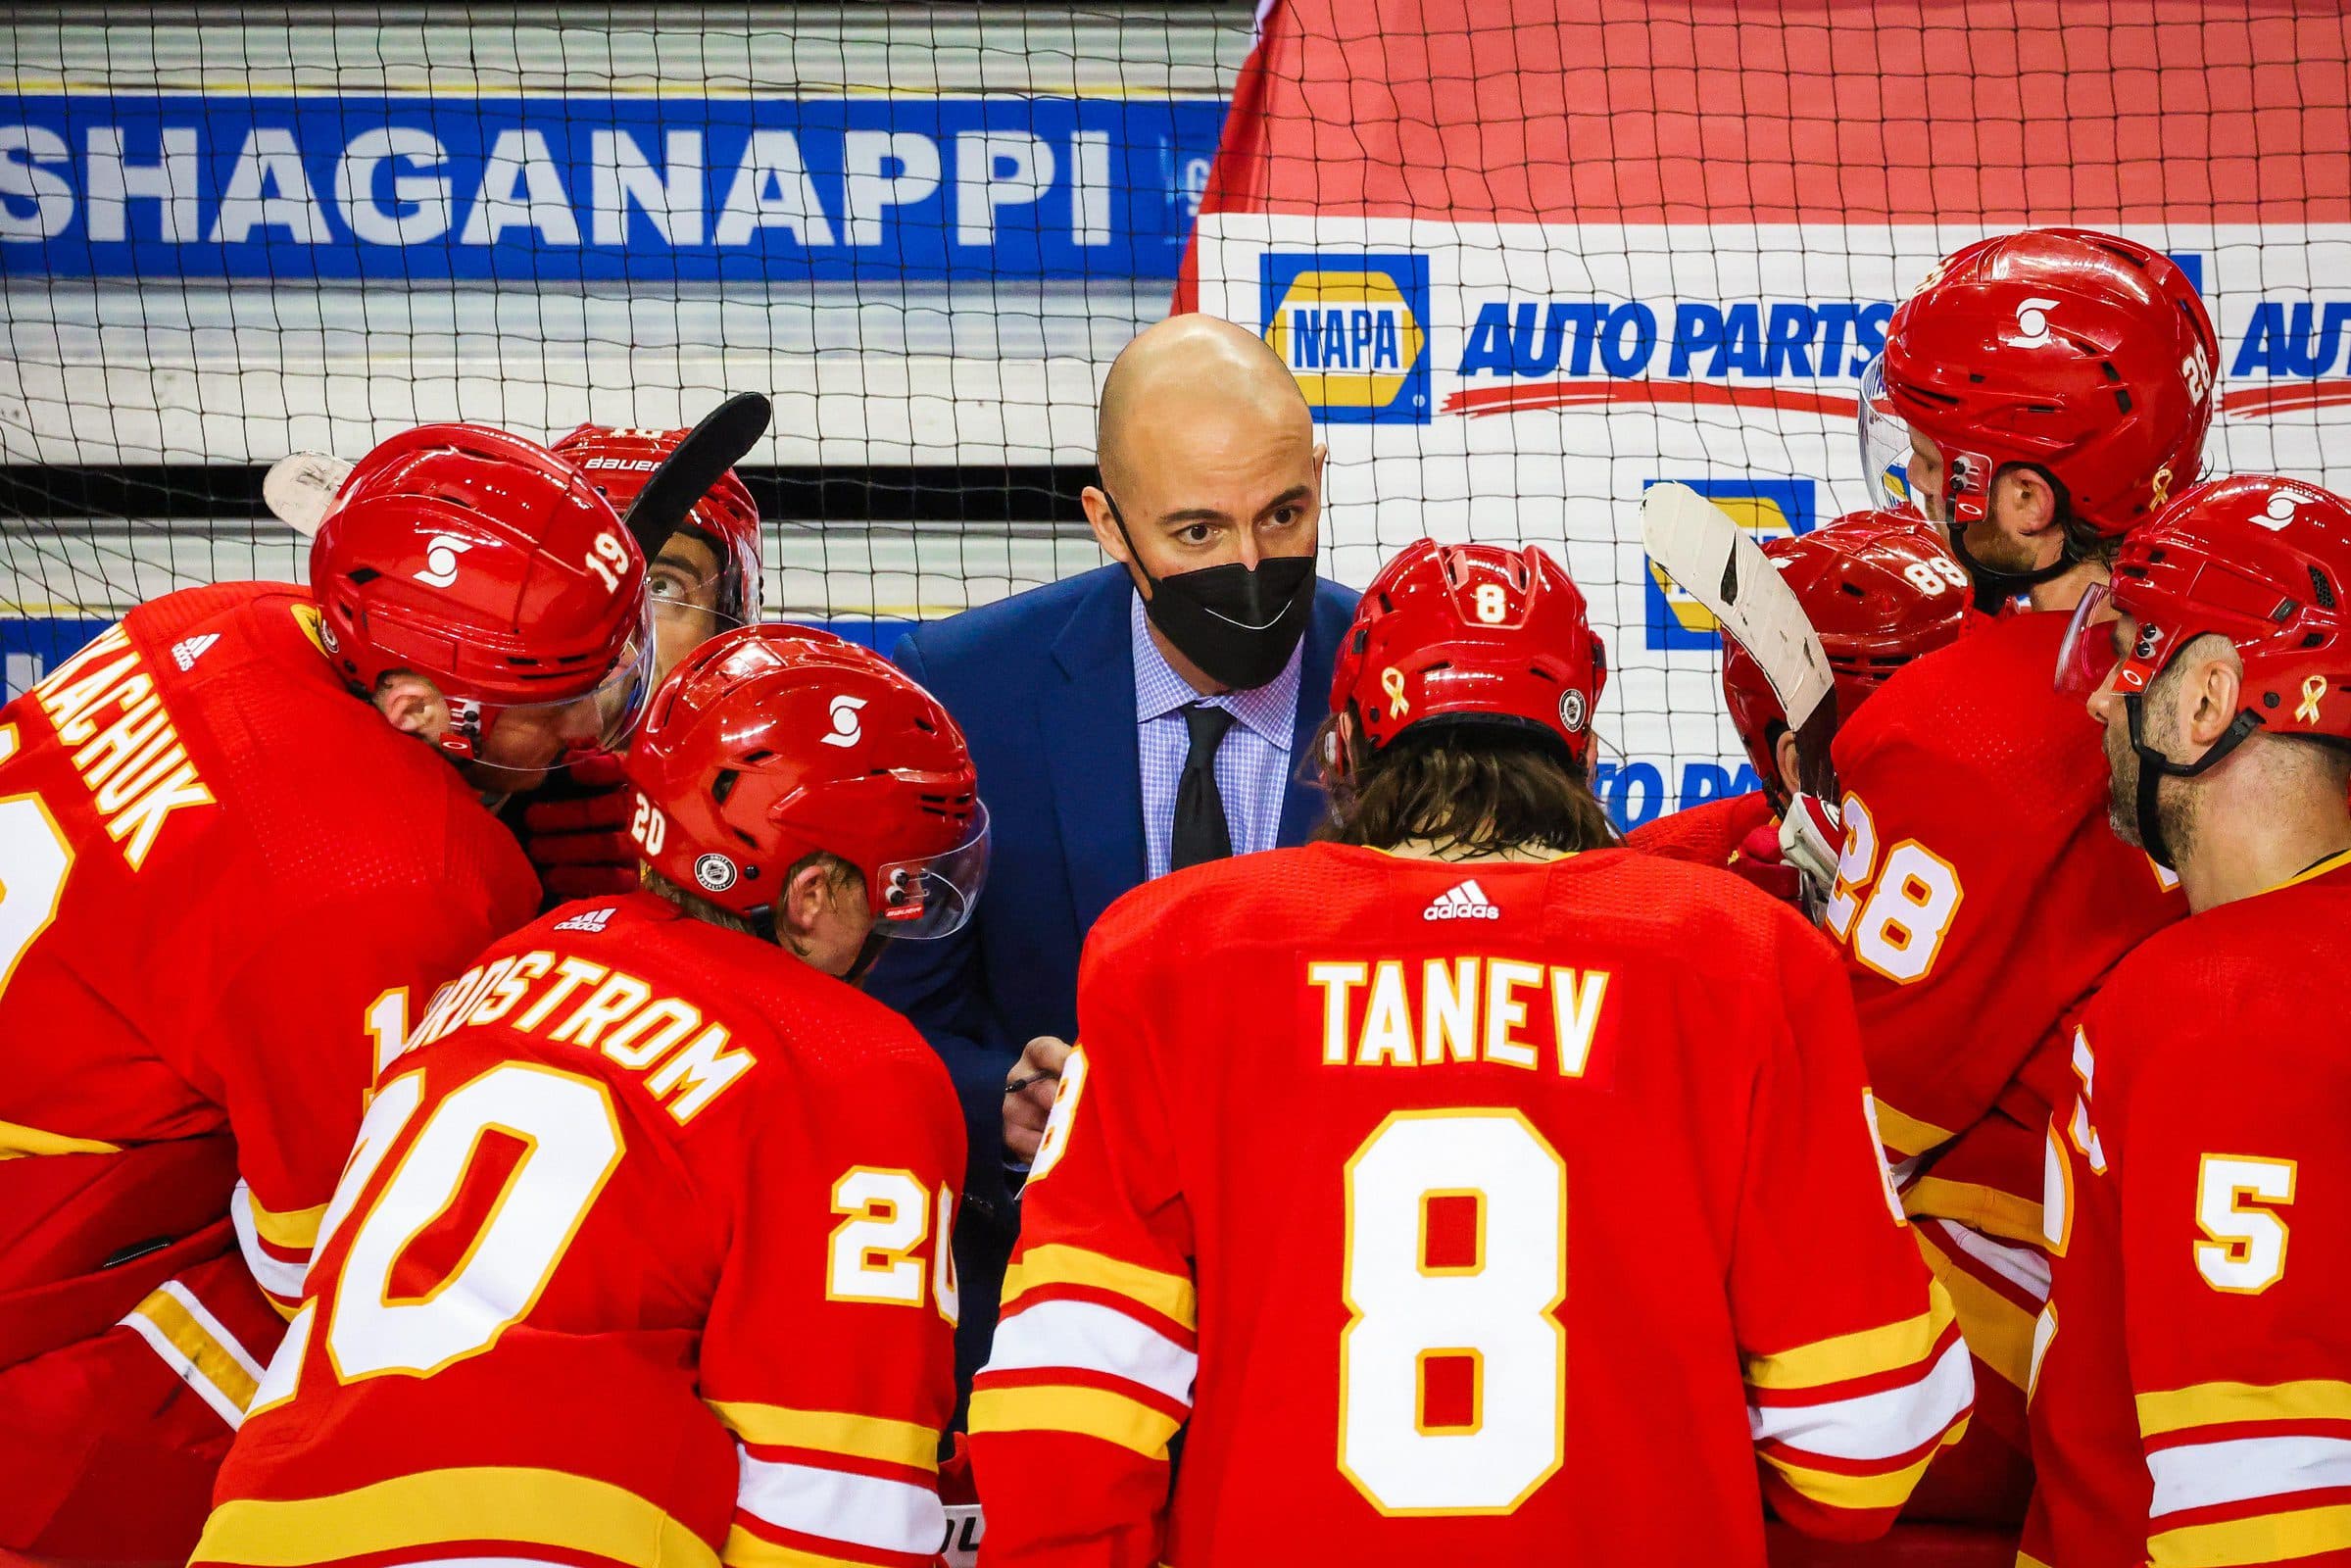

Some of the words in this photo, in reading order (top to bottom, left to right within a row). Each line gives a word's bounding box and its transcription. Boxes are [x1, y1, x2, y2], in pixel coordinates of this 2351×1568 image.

[0, 125, 1110, 246] SHAGANAPPI
[1294, 309, 1398, 368] NAPA
[1457, 302, 1658, 378] AUTO
[1668, 302, 1895, 378] PARTS
[2182, 342, 2211, 407] 28
[585, 532, 629, 594] 19
[1904, 556, 1968, 596] 88
[1475, 583, 1506, 623] 8
[631, 792, 666, 856] 20
[1423, 902, 1500, 921] adidas
[1826, 790, 1964, 986] 28
[402, 951, 758, 1127] RDSTROM
[1308, 956, 1610, 1078] TANEV
[1026, 1044, 1089, 1185] 8
[2193, 1152, 2297, 1296] 5
[1337, 1106, 1567, 1517] 8
